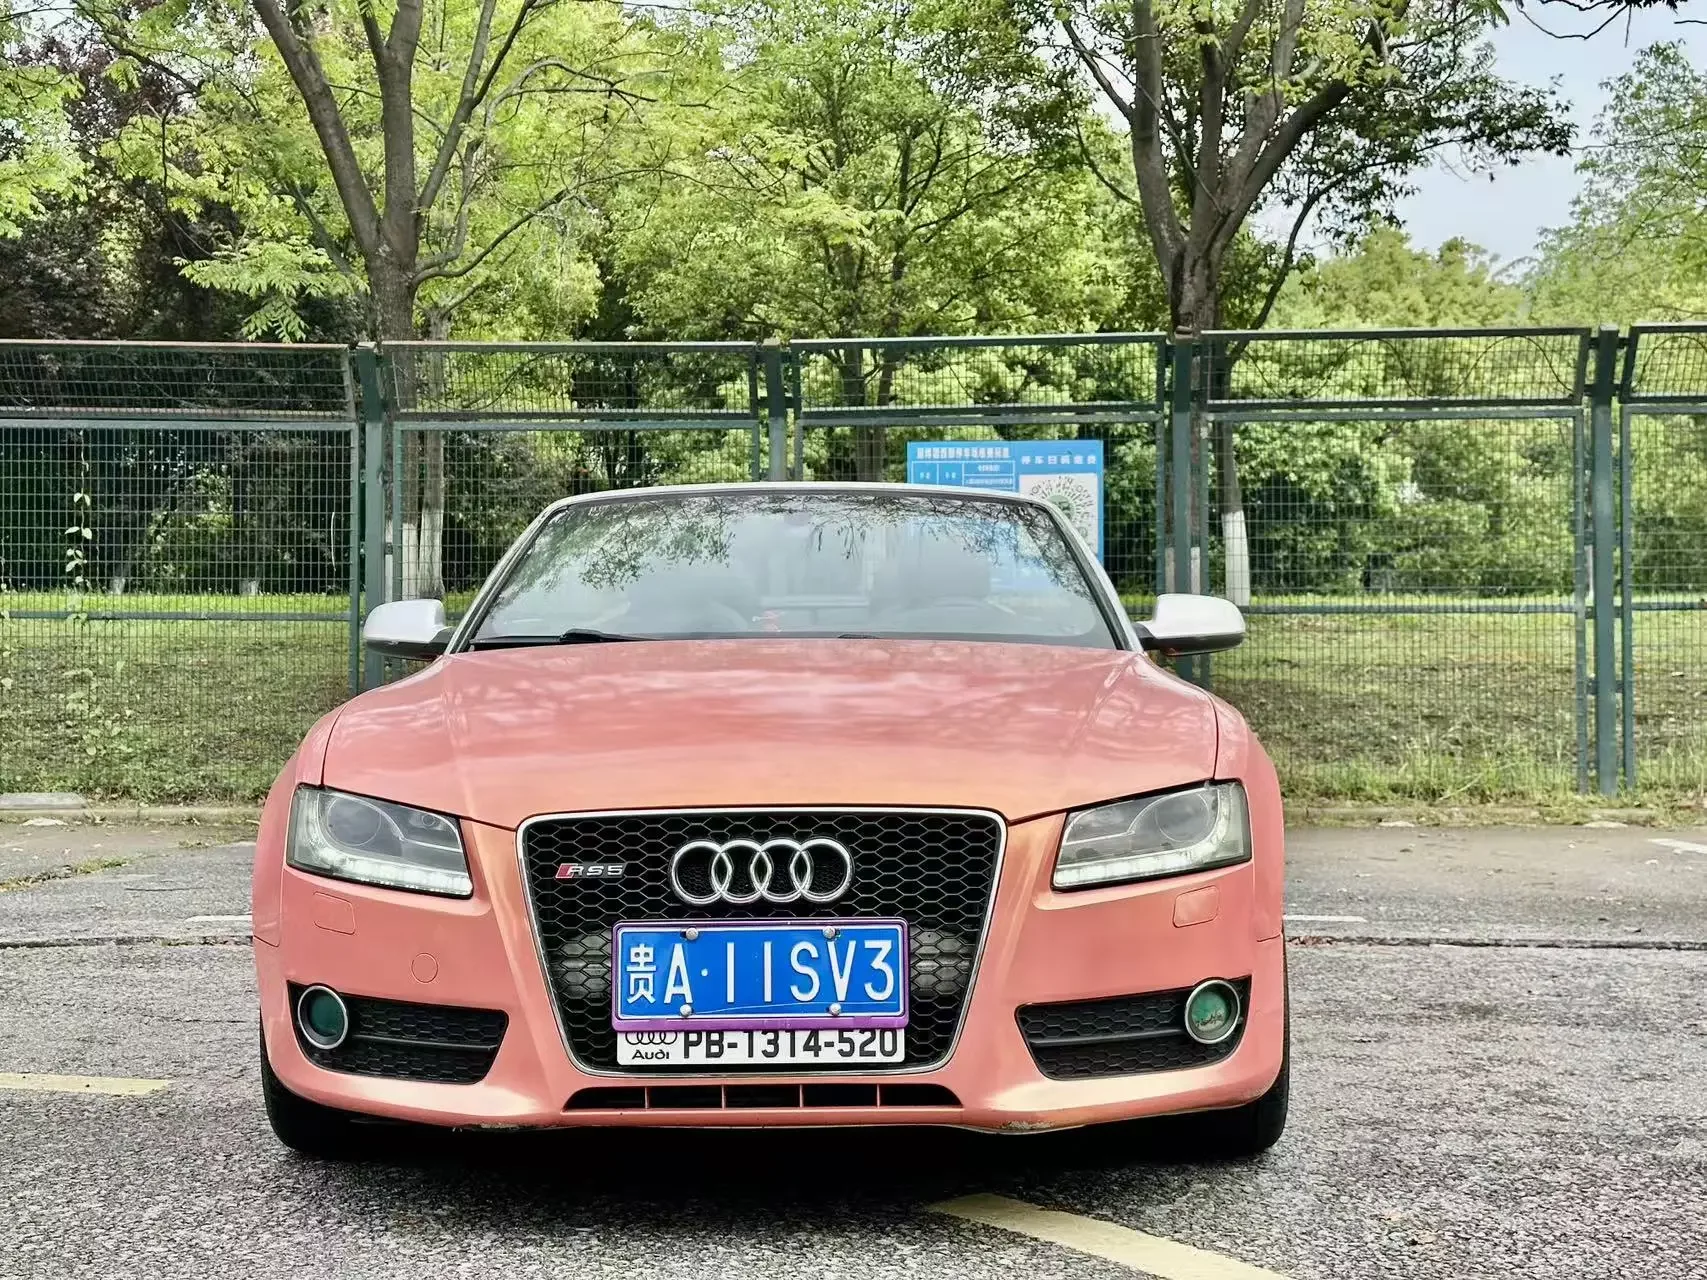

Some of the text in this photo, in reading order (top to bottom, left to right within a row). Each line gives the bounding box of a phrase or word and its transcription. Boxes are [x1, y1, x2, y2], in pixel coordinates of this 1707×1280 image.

[560, 864, 624, 877] RS5
[683, 1029, 898, 1059] PB-1314-520
[631, 1049, 670, 1060] Audi
